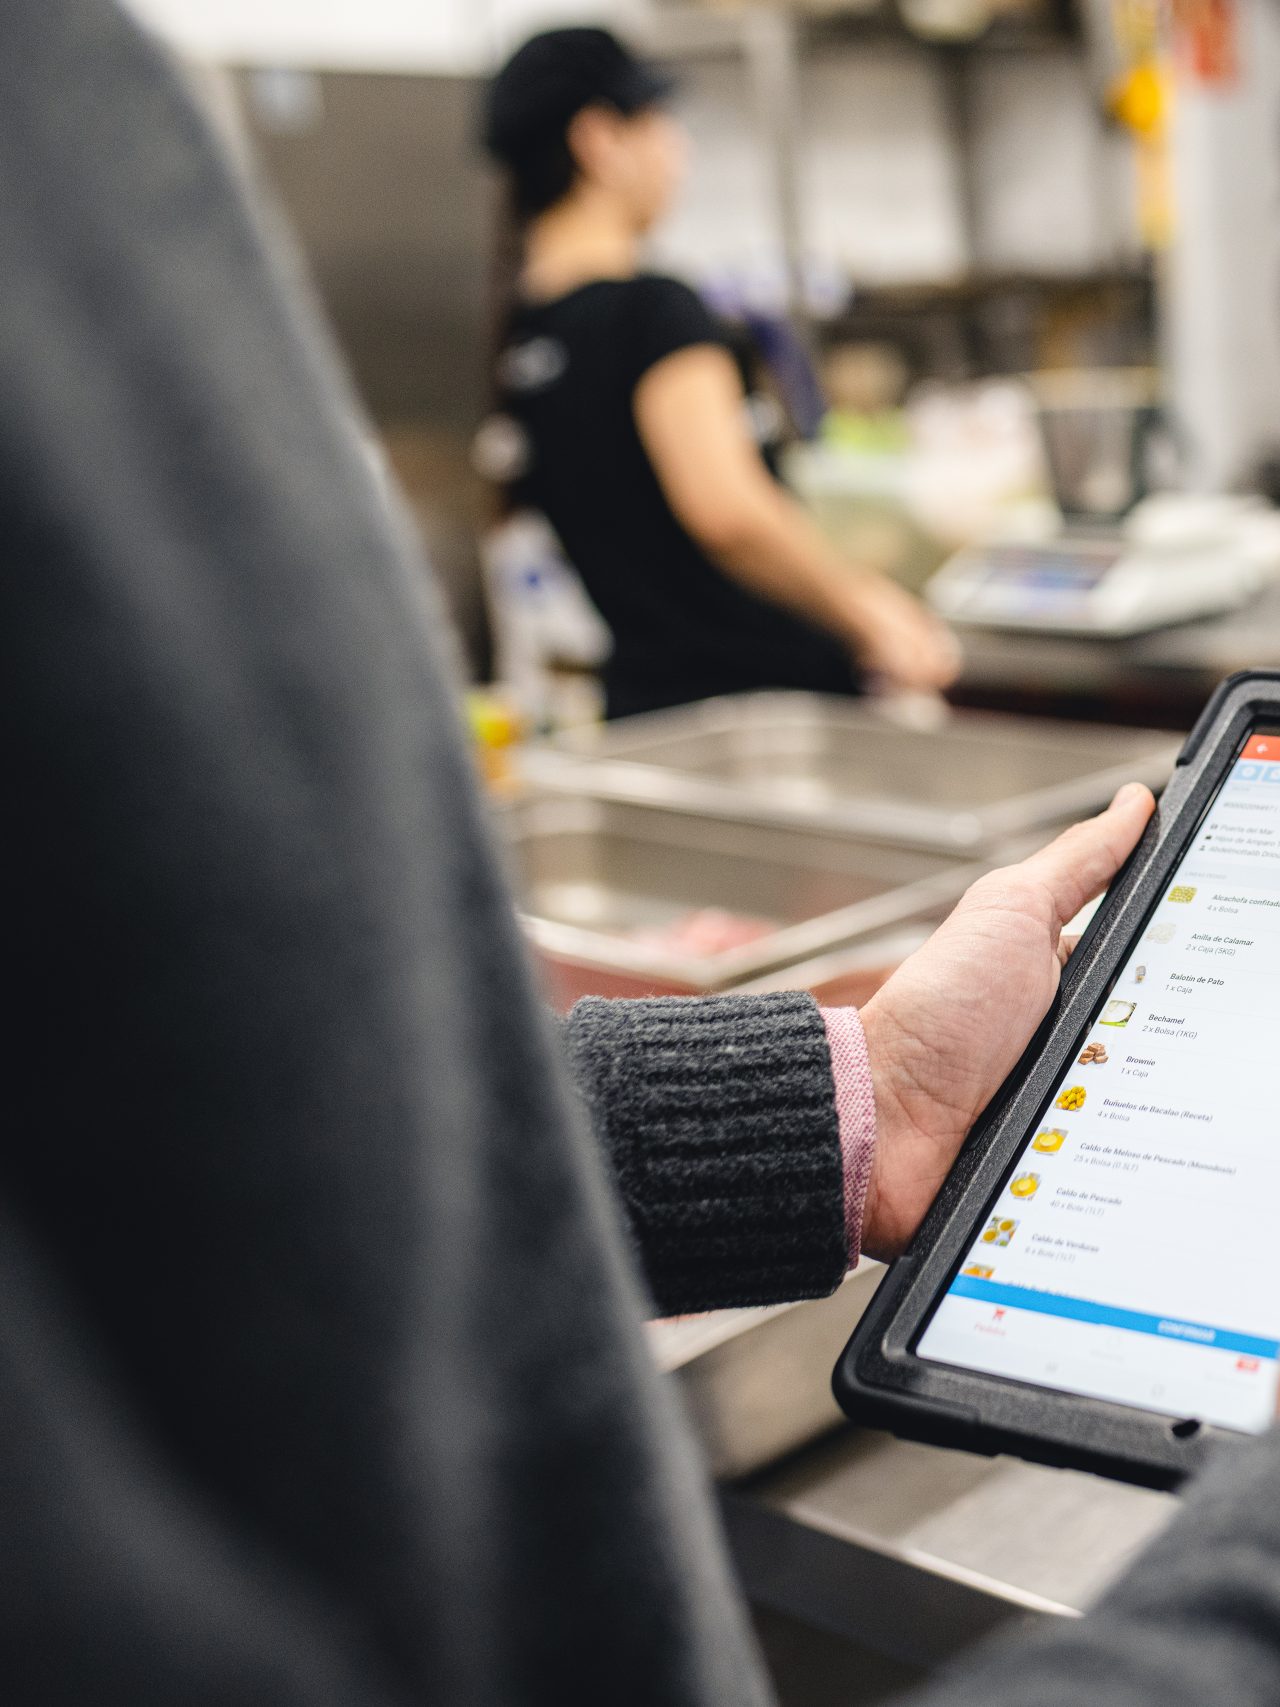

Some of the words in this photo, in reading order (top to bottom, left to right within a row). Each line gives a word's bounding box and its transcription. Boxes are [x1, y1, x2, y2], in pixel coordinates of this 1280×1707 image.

[1211, 894, 1248, 904] Alcachofa
[1218, 906, 1239, 914] Bolsa
[1191, 933, 1212, 942] Anilla
[1213, 934, 1223, 943] de
[1224, 937, 1254, 946] Calamar
[1185, 943, 1191, 951] 2
[1198, 945, 1214, 954] Caja
[1215, 947, 1236, 957] (5KG)
[1196, 975, 1206, 984] de
[1207, 977, 1225, 986] Pato
[1176, 985, 1193, 995] Caja
[1148, 1013, 1186, 1025] Bechamel
[1154, 1026, 1175, 1036] Bolsa
[1176, 1029, 1198, 1040] (1KG)
[1125, 1055, 1156, 1066] Brownie
[1132, 1068, 1149, 1079] Caja
[1103, 1098, 1137, 1110] Buñuelos
[1138, 1103, 1148, 1111] de
[1149, 1105, 1180, 1117] Bacalao
[1180, 1110, 1214, 1123] (Receta)
[1109, 1112, 1130, 1122] Bolsa
[1080, 1142, 1101, 1152] Caldo
[1102, 1146, 1112, 1154] de
[1113, 1147, 1141, 1159] Meloso
[1142, 1152, 1152, 1161] de
[1153, 1154, 1187, 1166] Pescado
[1056, 1187, 1077, 1197] Caldo
[1078, 1191, 1088, 1200] de
[1089, 1193, 1122, 1206] Pescado
[1031, 1233, 1053, 1244] Caldo
[1053, 1238, 1063, 1246] de
